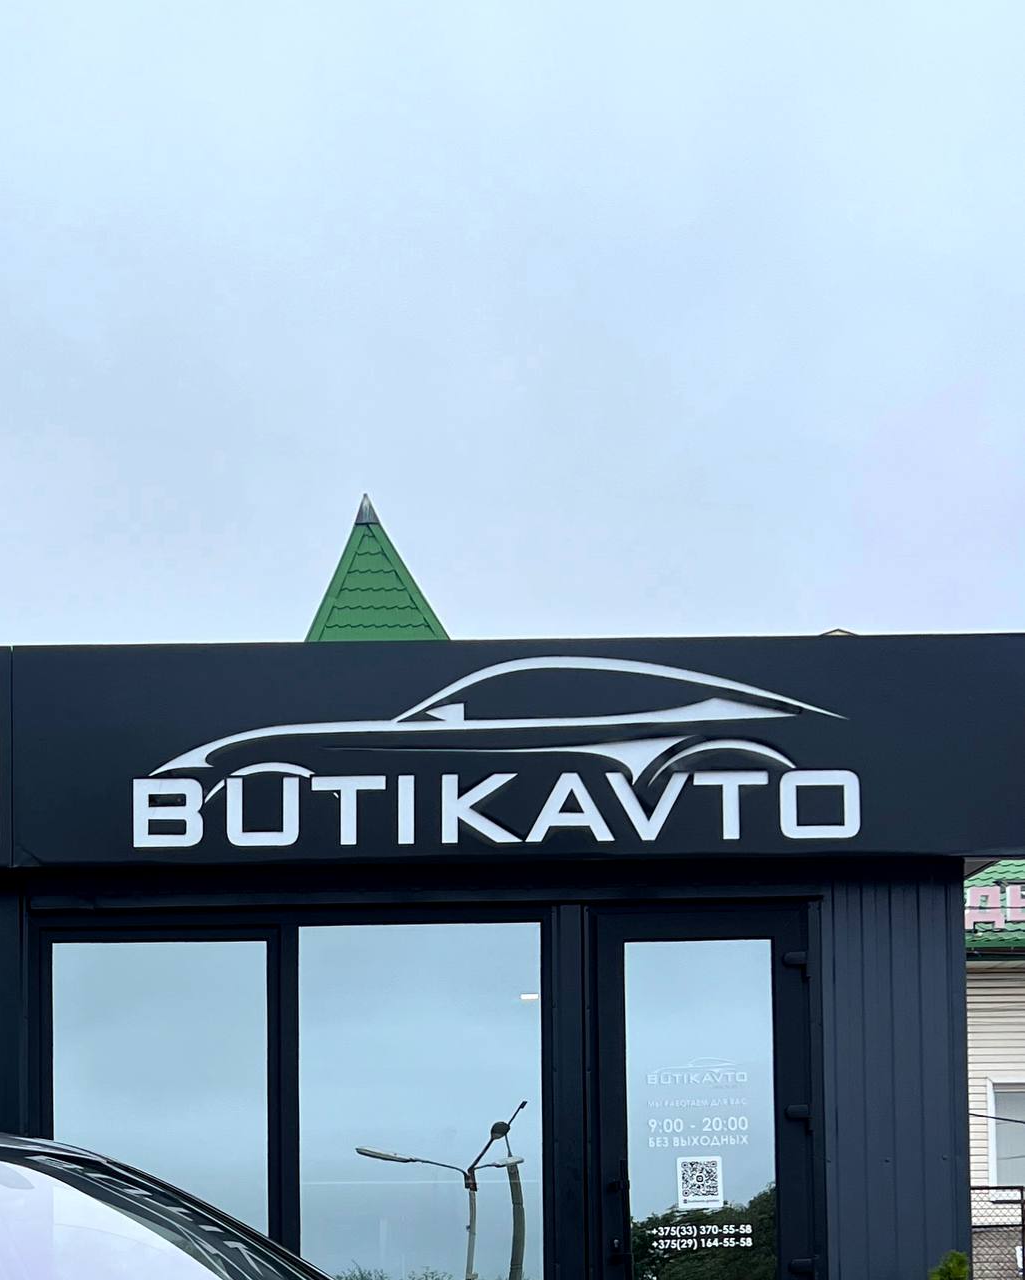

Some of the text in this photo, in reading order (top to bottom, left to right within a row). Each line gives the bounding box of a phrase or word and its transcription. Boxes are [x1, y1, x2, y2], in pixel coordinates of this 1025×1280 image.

[133, 769, 861, 849] BUTIKAVTO
[647, 1071, 748, 1085] BUTIKAVTO
[648, 1118, 684, 1133] 9:00
[702, 1116, 749, 1132] 20:00
[648, 1135, 749, 1148] БЕЗ ВЫХОДНЫХ
[651, 1224, 753, 1237] +375(33) 370-55-58
[651, 1237, 753, 1250] +375(29) 164-55-58
